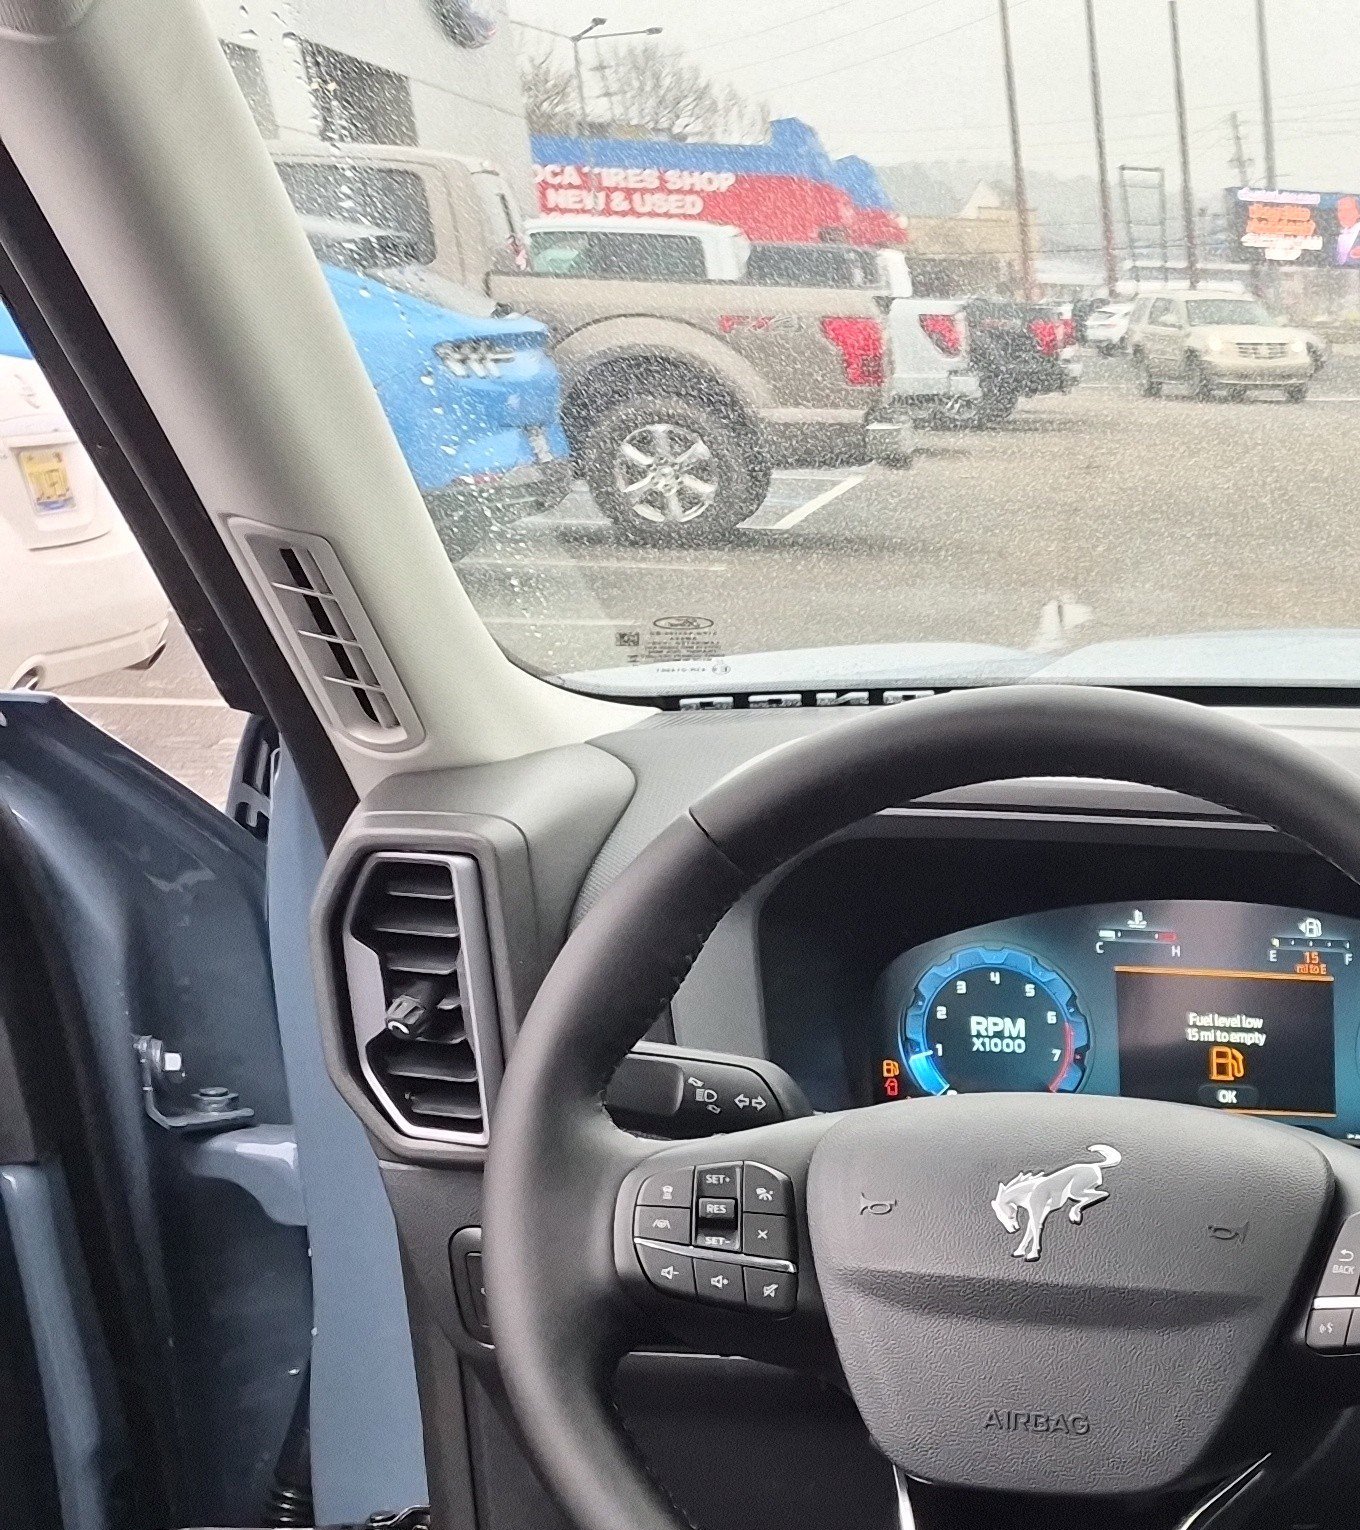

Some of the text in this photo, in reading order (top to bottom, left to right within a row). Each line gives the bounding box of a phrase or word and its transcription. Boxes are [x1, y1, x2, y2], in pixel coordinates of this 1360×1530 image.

[664, 170, 736, 192] SHOP
[546, 188, 704, 214] NEW & USED
[1095, 942, 1181, 958] C H
[1269, 949, 1353, 966] E F
[1303, 951, 1319, 964] 15
[1320, 963, 1327, 975] E
[989, 971, 1001, 985] 4
[956, 980, 967, 994] 3
[1024, 983, 1036, 997] 5
[936, 1005, 947, 1020] 2
[1046, 1011, 1057, 1025] 6
[969, 1015, 1027, 1038] RPM
[1188, 1011, 1264, 1029] Fuel level low
[1186, 1028, 1199, 1041] 15
[1216, 1029, 1229, 1043] to
[1229, 1031, 1267, 1047] empty
[935, 1043, 943, 1057] 1
[971, 1037, 1027, 1054] X1000
[1051, 1048, 1062, 1062] 7
[1217, 1089, 1238, 1104] OK
[705, 1174, 731, 1184] SET+
[706, 1204, 727, 1214] RES
[705, 1236, 731, 1246] SET-
[1332, 1264, 1355, 1275] BACK
[983, 1408, 1091, 1436] AIRBAG
